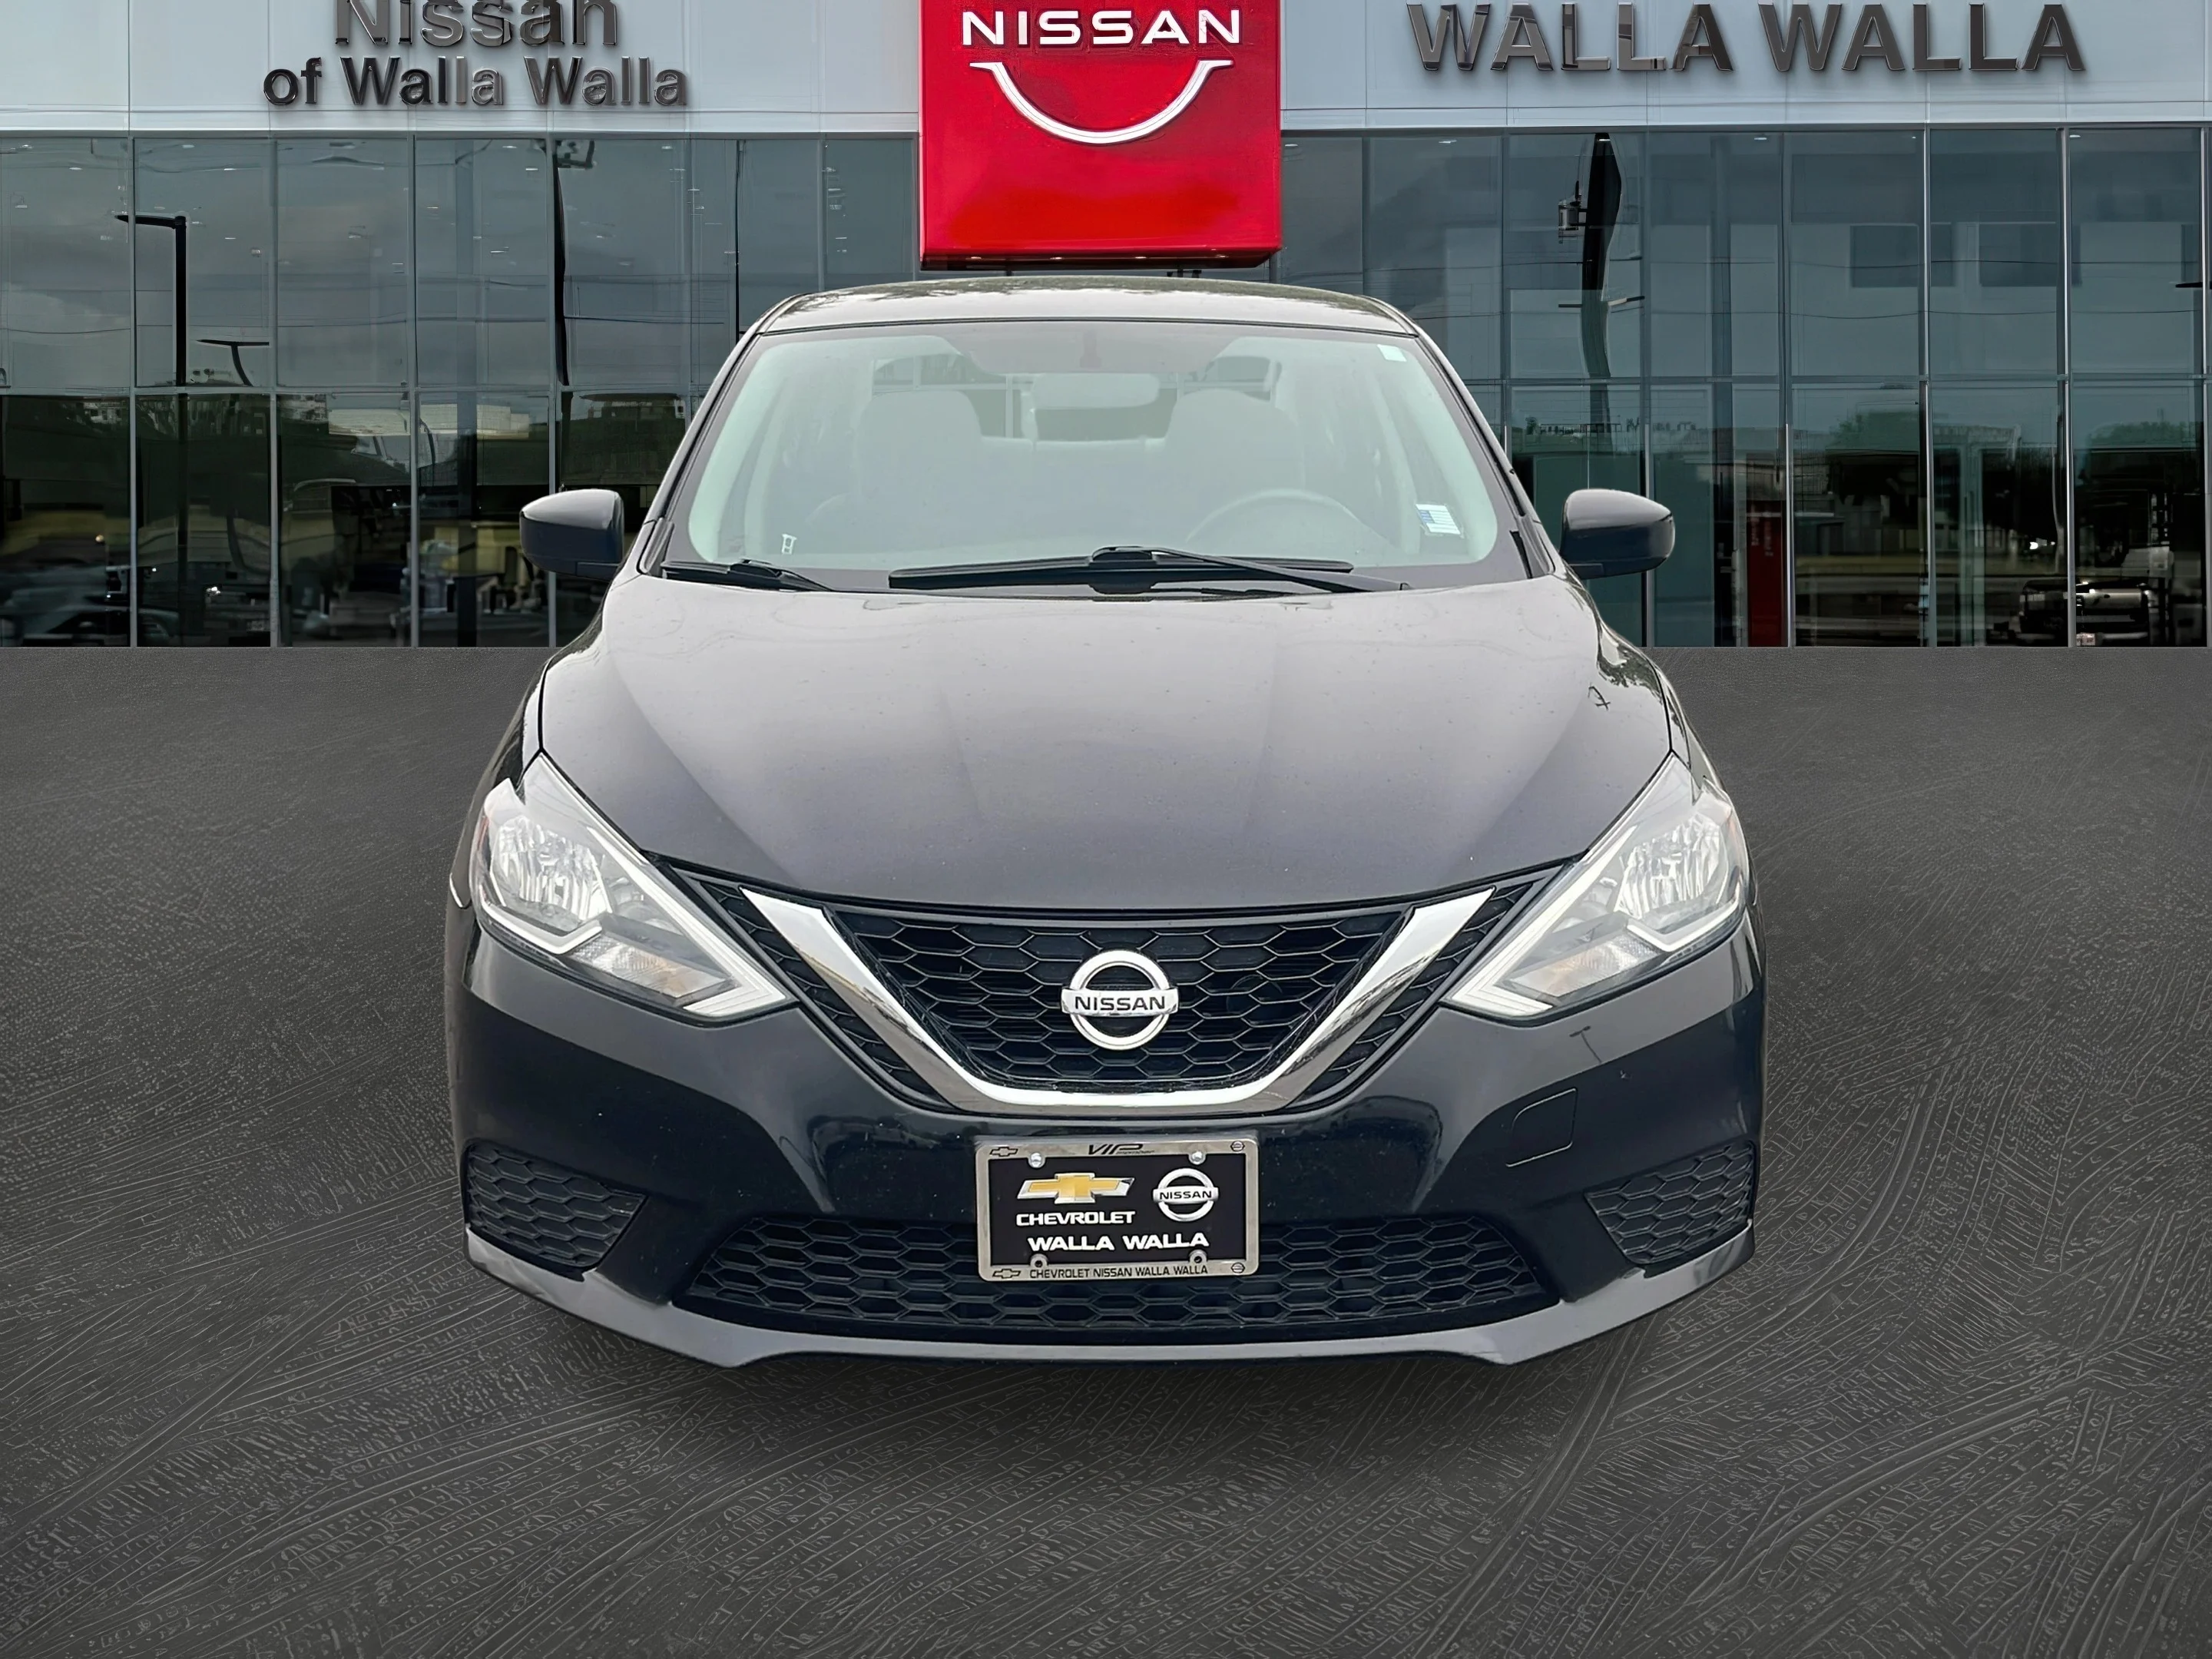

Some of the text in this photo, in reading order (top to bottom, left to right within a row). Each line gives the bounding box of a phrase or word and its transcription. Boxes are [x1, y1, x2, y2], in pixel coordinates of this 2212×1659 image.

[335, 0, 618, 47] Nissan
[962, 9, 1241, 46] NISSAN
[1406, 2, 2086, 71] WALLA WALLA
[263, 56, 687, 106] of Walla Walla
[1075, 995, 1165, 1011] NISSAN
[1088, 1144, 1144, 1155] VIP
[1159, 1190, 1213, 1200] NISSAN
[1016, 1210, 1136, 1227] CHEVROLET
[1028, 1232, 1210, 1252] WALLA WALLA
[1029, 1265, 1208, 1279] CHEVROLET NISSAN WALLA WALLA
